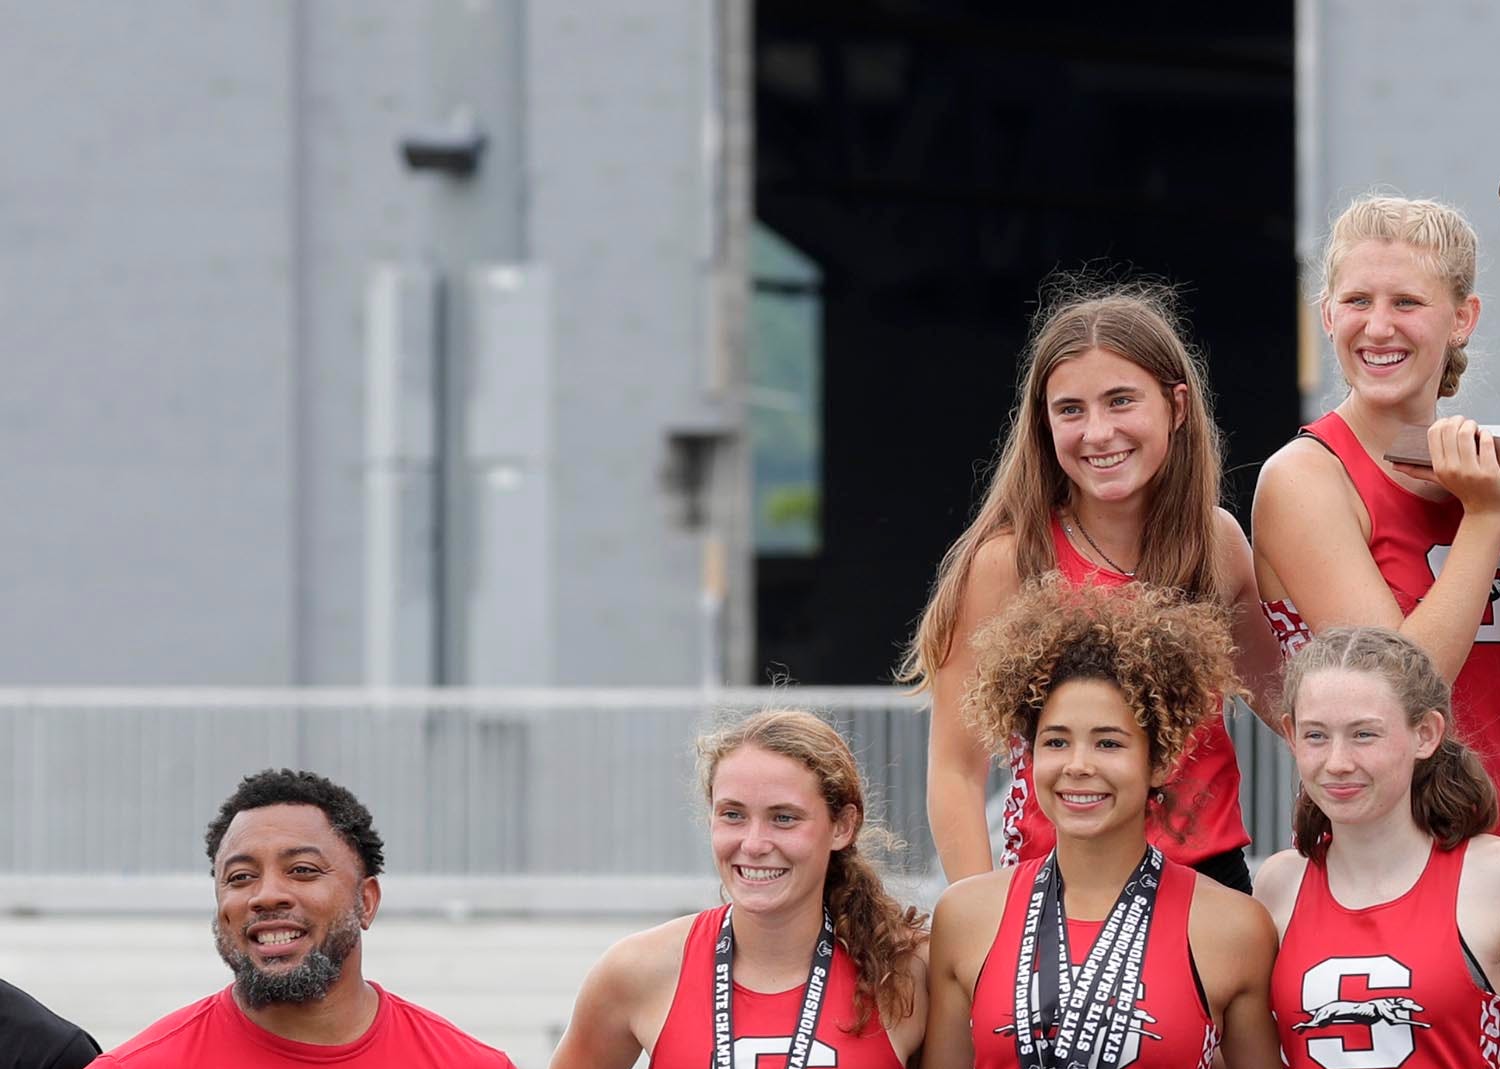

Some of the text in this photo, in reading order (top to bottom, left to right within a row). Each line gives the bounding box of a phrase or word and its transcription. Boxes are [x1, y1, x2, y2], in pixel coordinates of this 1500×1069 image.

[716, 963, 729, 1012] STATE
[1016, 891, 1044, 1055] STATE CHAMPIONSHIPS
[1077, 894, 1147, 1052] STATE CHAMPIONSHIPS
[1054, 1009, 1080, 1060] STATE
[1103, 1012, 1129, 1064] STATE
